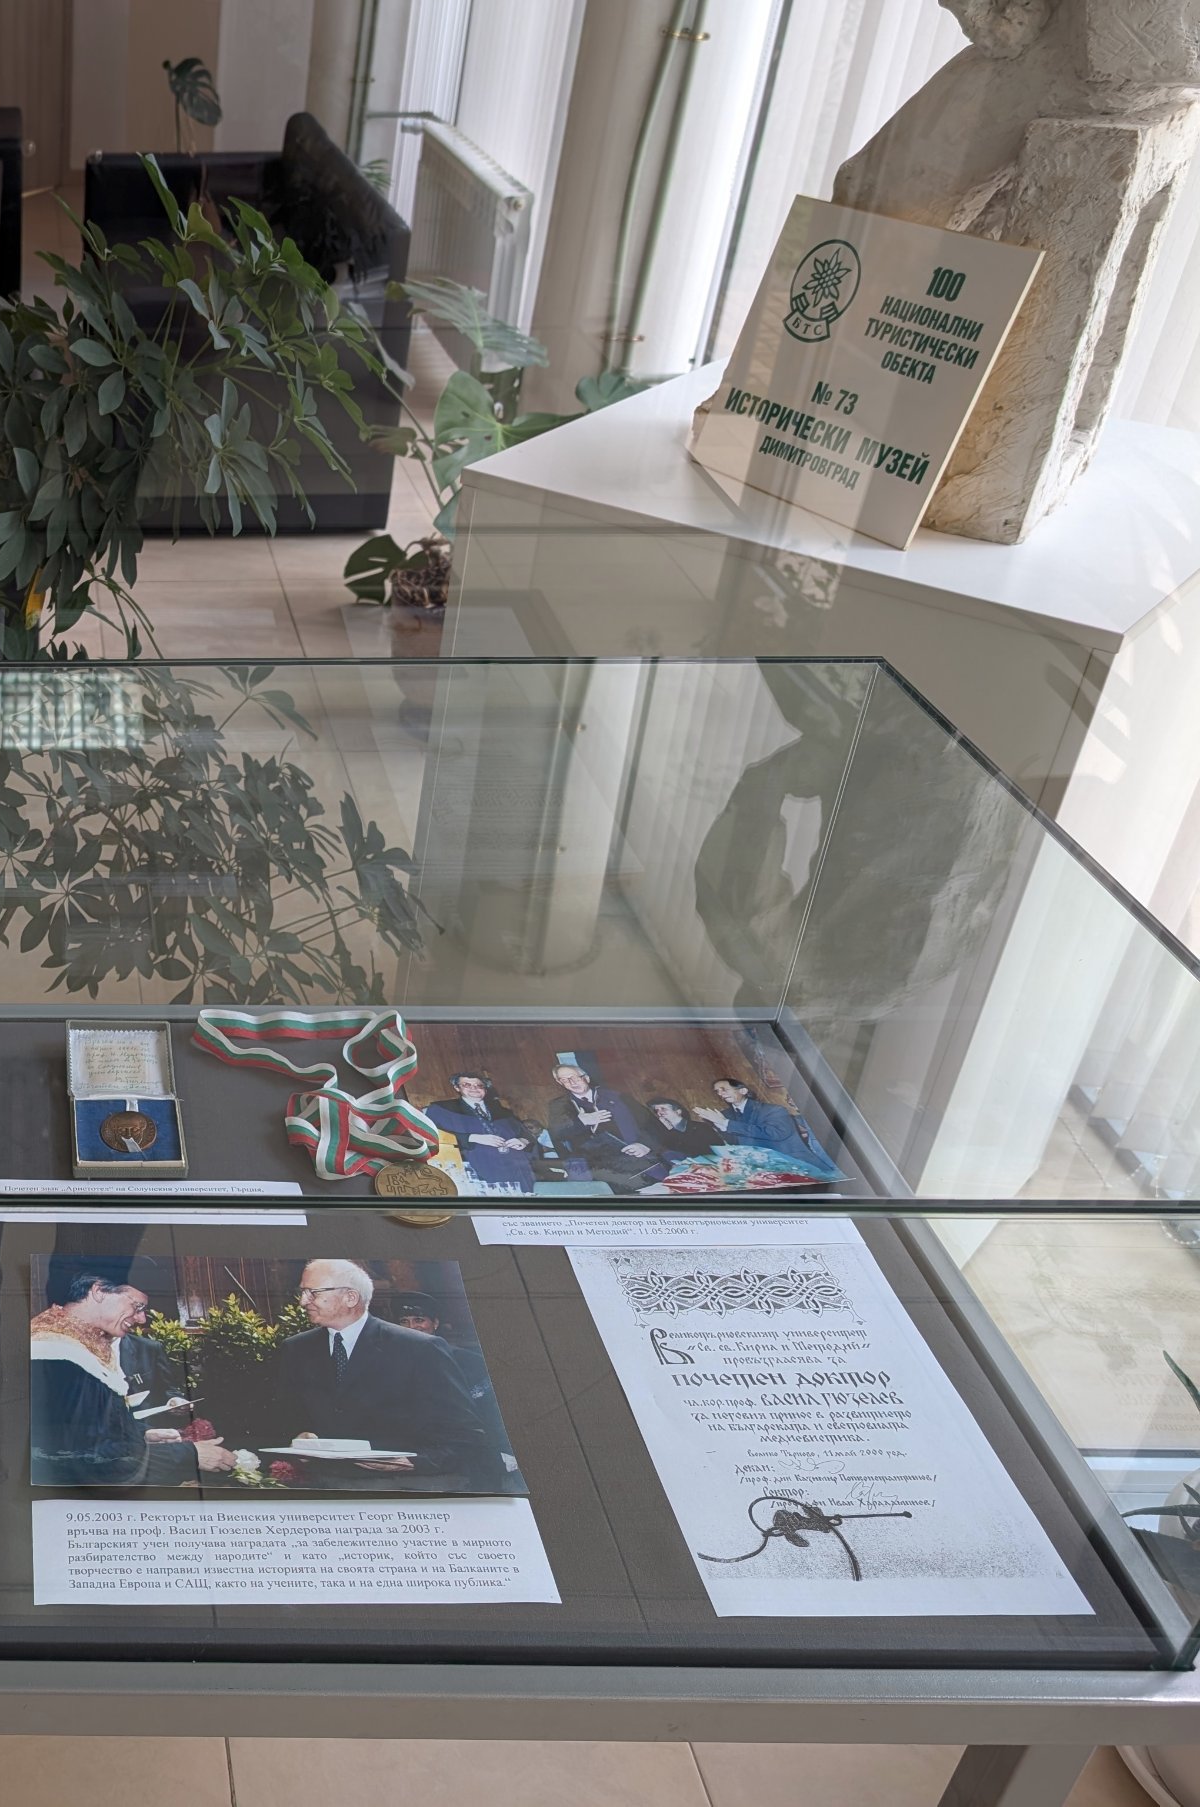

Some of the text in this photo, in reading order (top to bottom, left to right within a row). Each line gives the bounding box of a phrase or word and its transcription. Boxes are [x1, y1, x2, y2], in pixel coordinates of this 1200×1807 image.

[926, 267, 966, 302] 100
[880, 296, 984, 342] НАЦИОНАЛНИ
[864, 318, 979, 369] ТУРИСТИЧЕСКИ
[881, 351, 936, 384] ОБЕКТА
[811, 382, 859, 415] № 73
[725, 387, 930, 485] ИСТОРИЧЕСКИ МУЗЕЙ
[759, 436, 860, 490] ДИМИТРОВГРАД
[64, 1513, 123, 1522] 9.05.2003
[140, 1513, 194, 1524] Ректорът
[217, 1512, 275, 1522] Виенския
[279, 1514, 354, 1524] университет
[359, 1512, 393, 1523] Георг
[397, 1511, 451, 1523] Винклер
[65, 1528, 109, 1538] връчва
[130, 1526, 165, 1538] проф.
[169, 1526, 206, 1535] Васил
[210, 1525, 262, 1535] Гюзелев
[266, 1525, 331, 1537] Хердерова
[335, 1527, 382, 1537] награда
[402, 1525, 430, 1534] 2003
[67, 1579, 116, 1591] Западна
[119, 1579, 161, 1591] Европа
[174, 1579, 211, 1591] САЩ,
[267, 1581, 317, 1590] учените,
[376, 1580, 403, 1590] една
[406, 1580, 451, 1590] широка
[454, 1578, 513, 1590] публика.“
